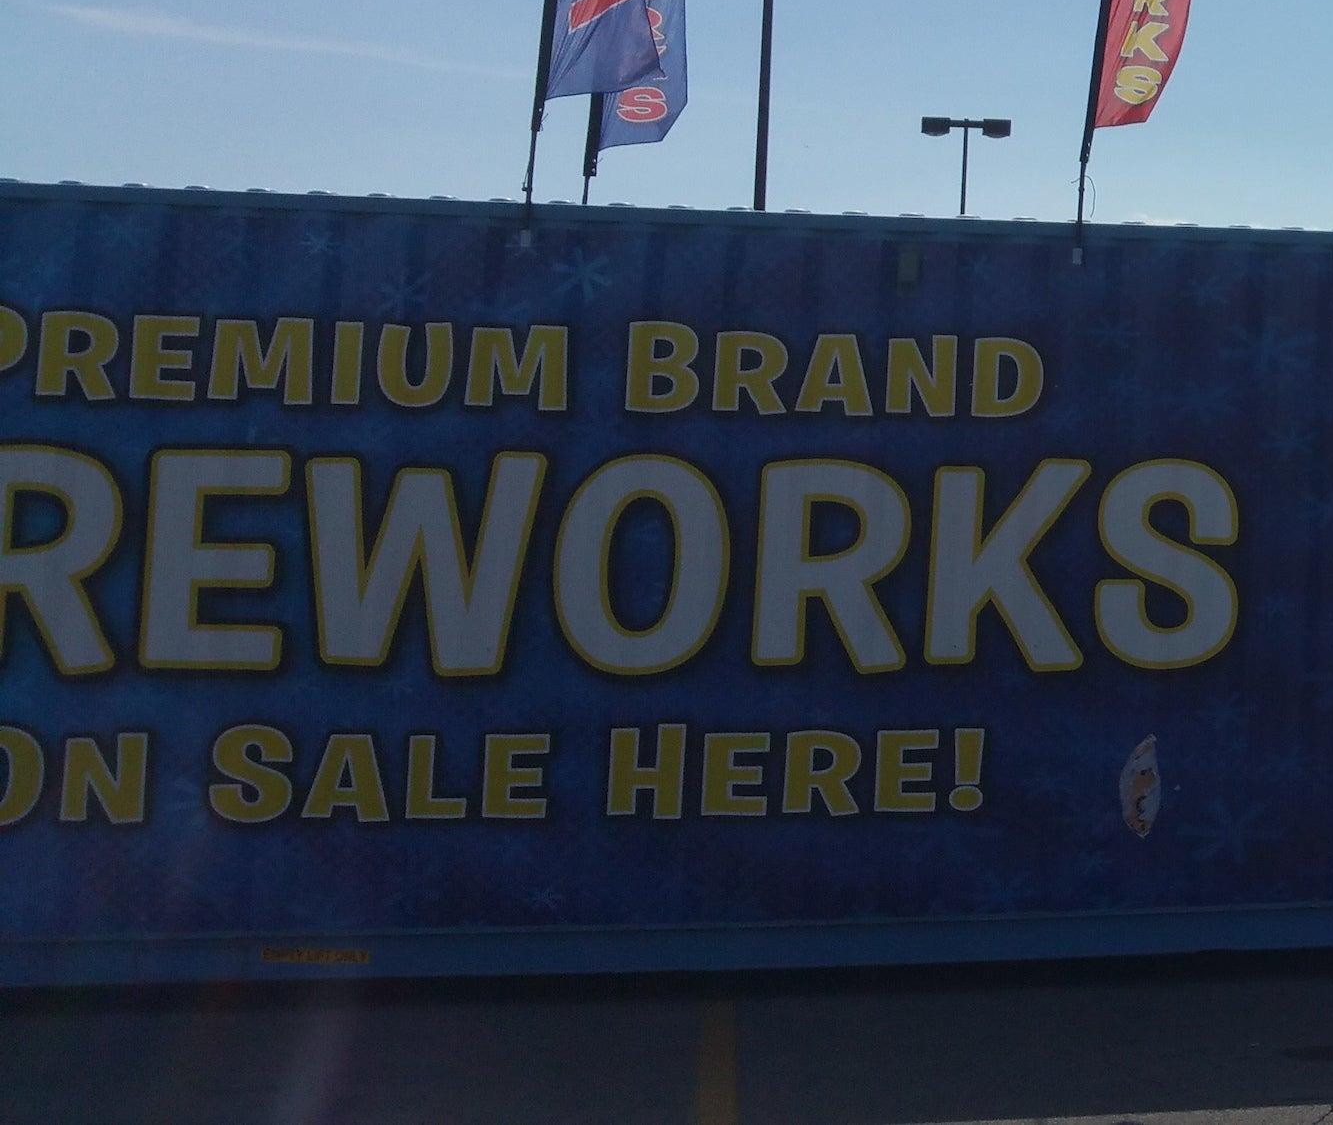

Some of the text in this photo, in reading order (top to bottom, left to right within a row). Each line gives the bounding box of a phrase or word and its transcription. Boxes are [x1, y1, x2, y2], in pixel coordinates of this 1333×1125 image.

[625, 320, 1045, 417] BRAND
[0, 444, 1239, 675] REWORKS
[209, 724, 550, 824] SALE
[607, 723, 985, 820] HERE!
